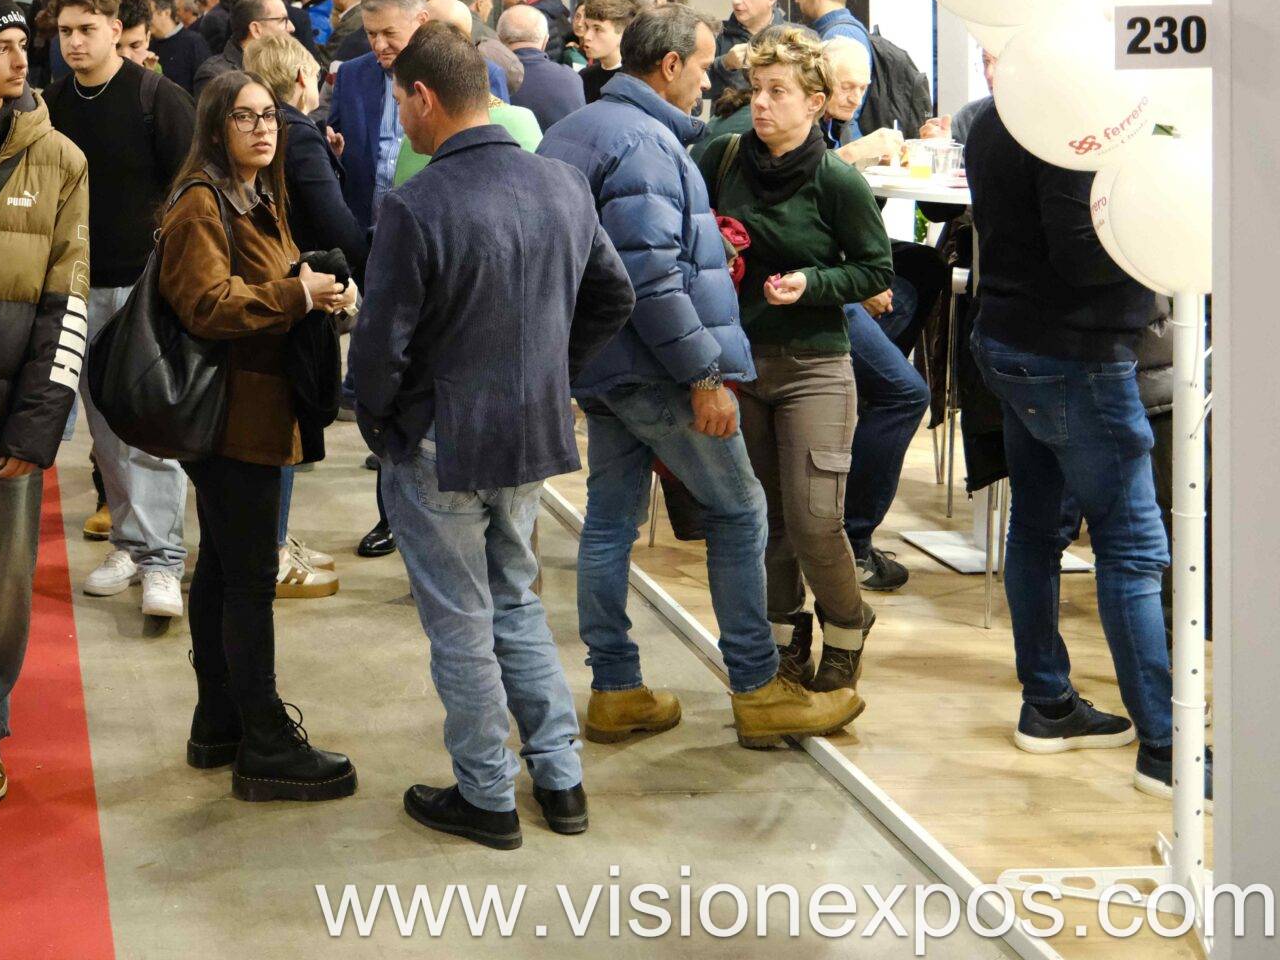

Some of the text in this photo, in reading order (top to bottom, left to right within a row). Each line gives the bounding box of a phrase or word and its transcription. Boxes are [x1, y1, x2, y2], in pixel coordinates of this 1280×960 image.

[1126, 16, 1207, 55] 230
[1104, 96, 1149, 140] ferrero
[7, 197, 33, 207] PUMA
